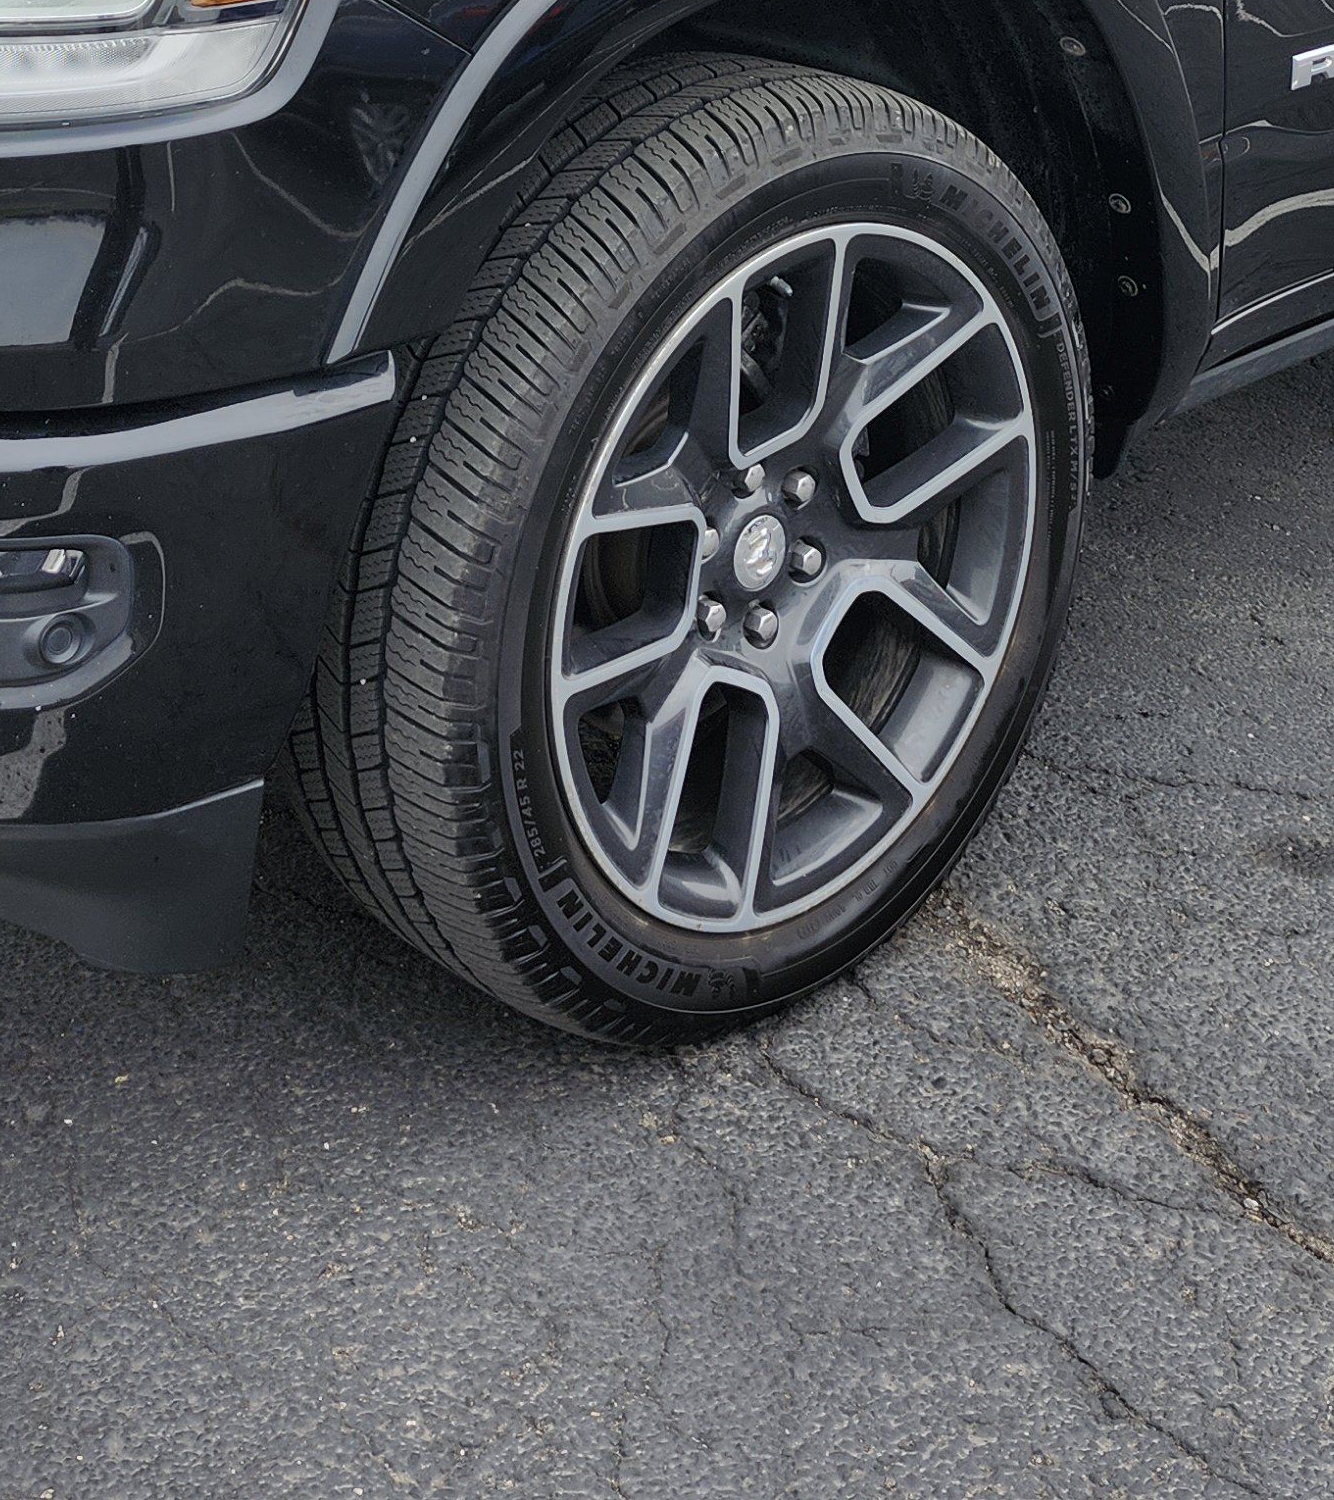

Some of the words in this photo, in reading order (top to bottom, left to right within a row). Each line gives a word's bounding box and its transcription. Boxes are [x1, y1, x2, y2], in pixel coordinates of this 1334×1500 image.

[939, 183, 1051, 311] MICHELIN
[1056, 342, 1076, 422] DEFENDER
[1068, 425, 1079, 456] LTX
[513, 748, 526, 772] 22
[516, 777, 528, 790] R
[519, 795, 547, 858] 285/45
[556, 888, 702, 997] MICHELIN
